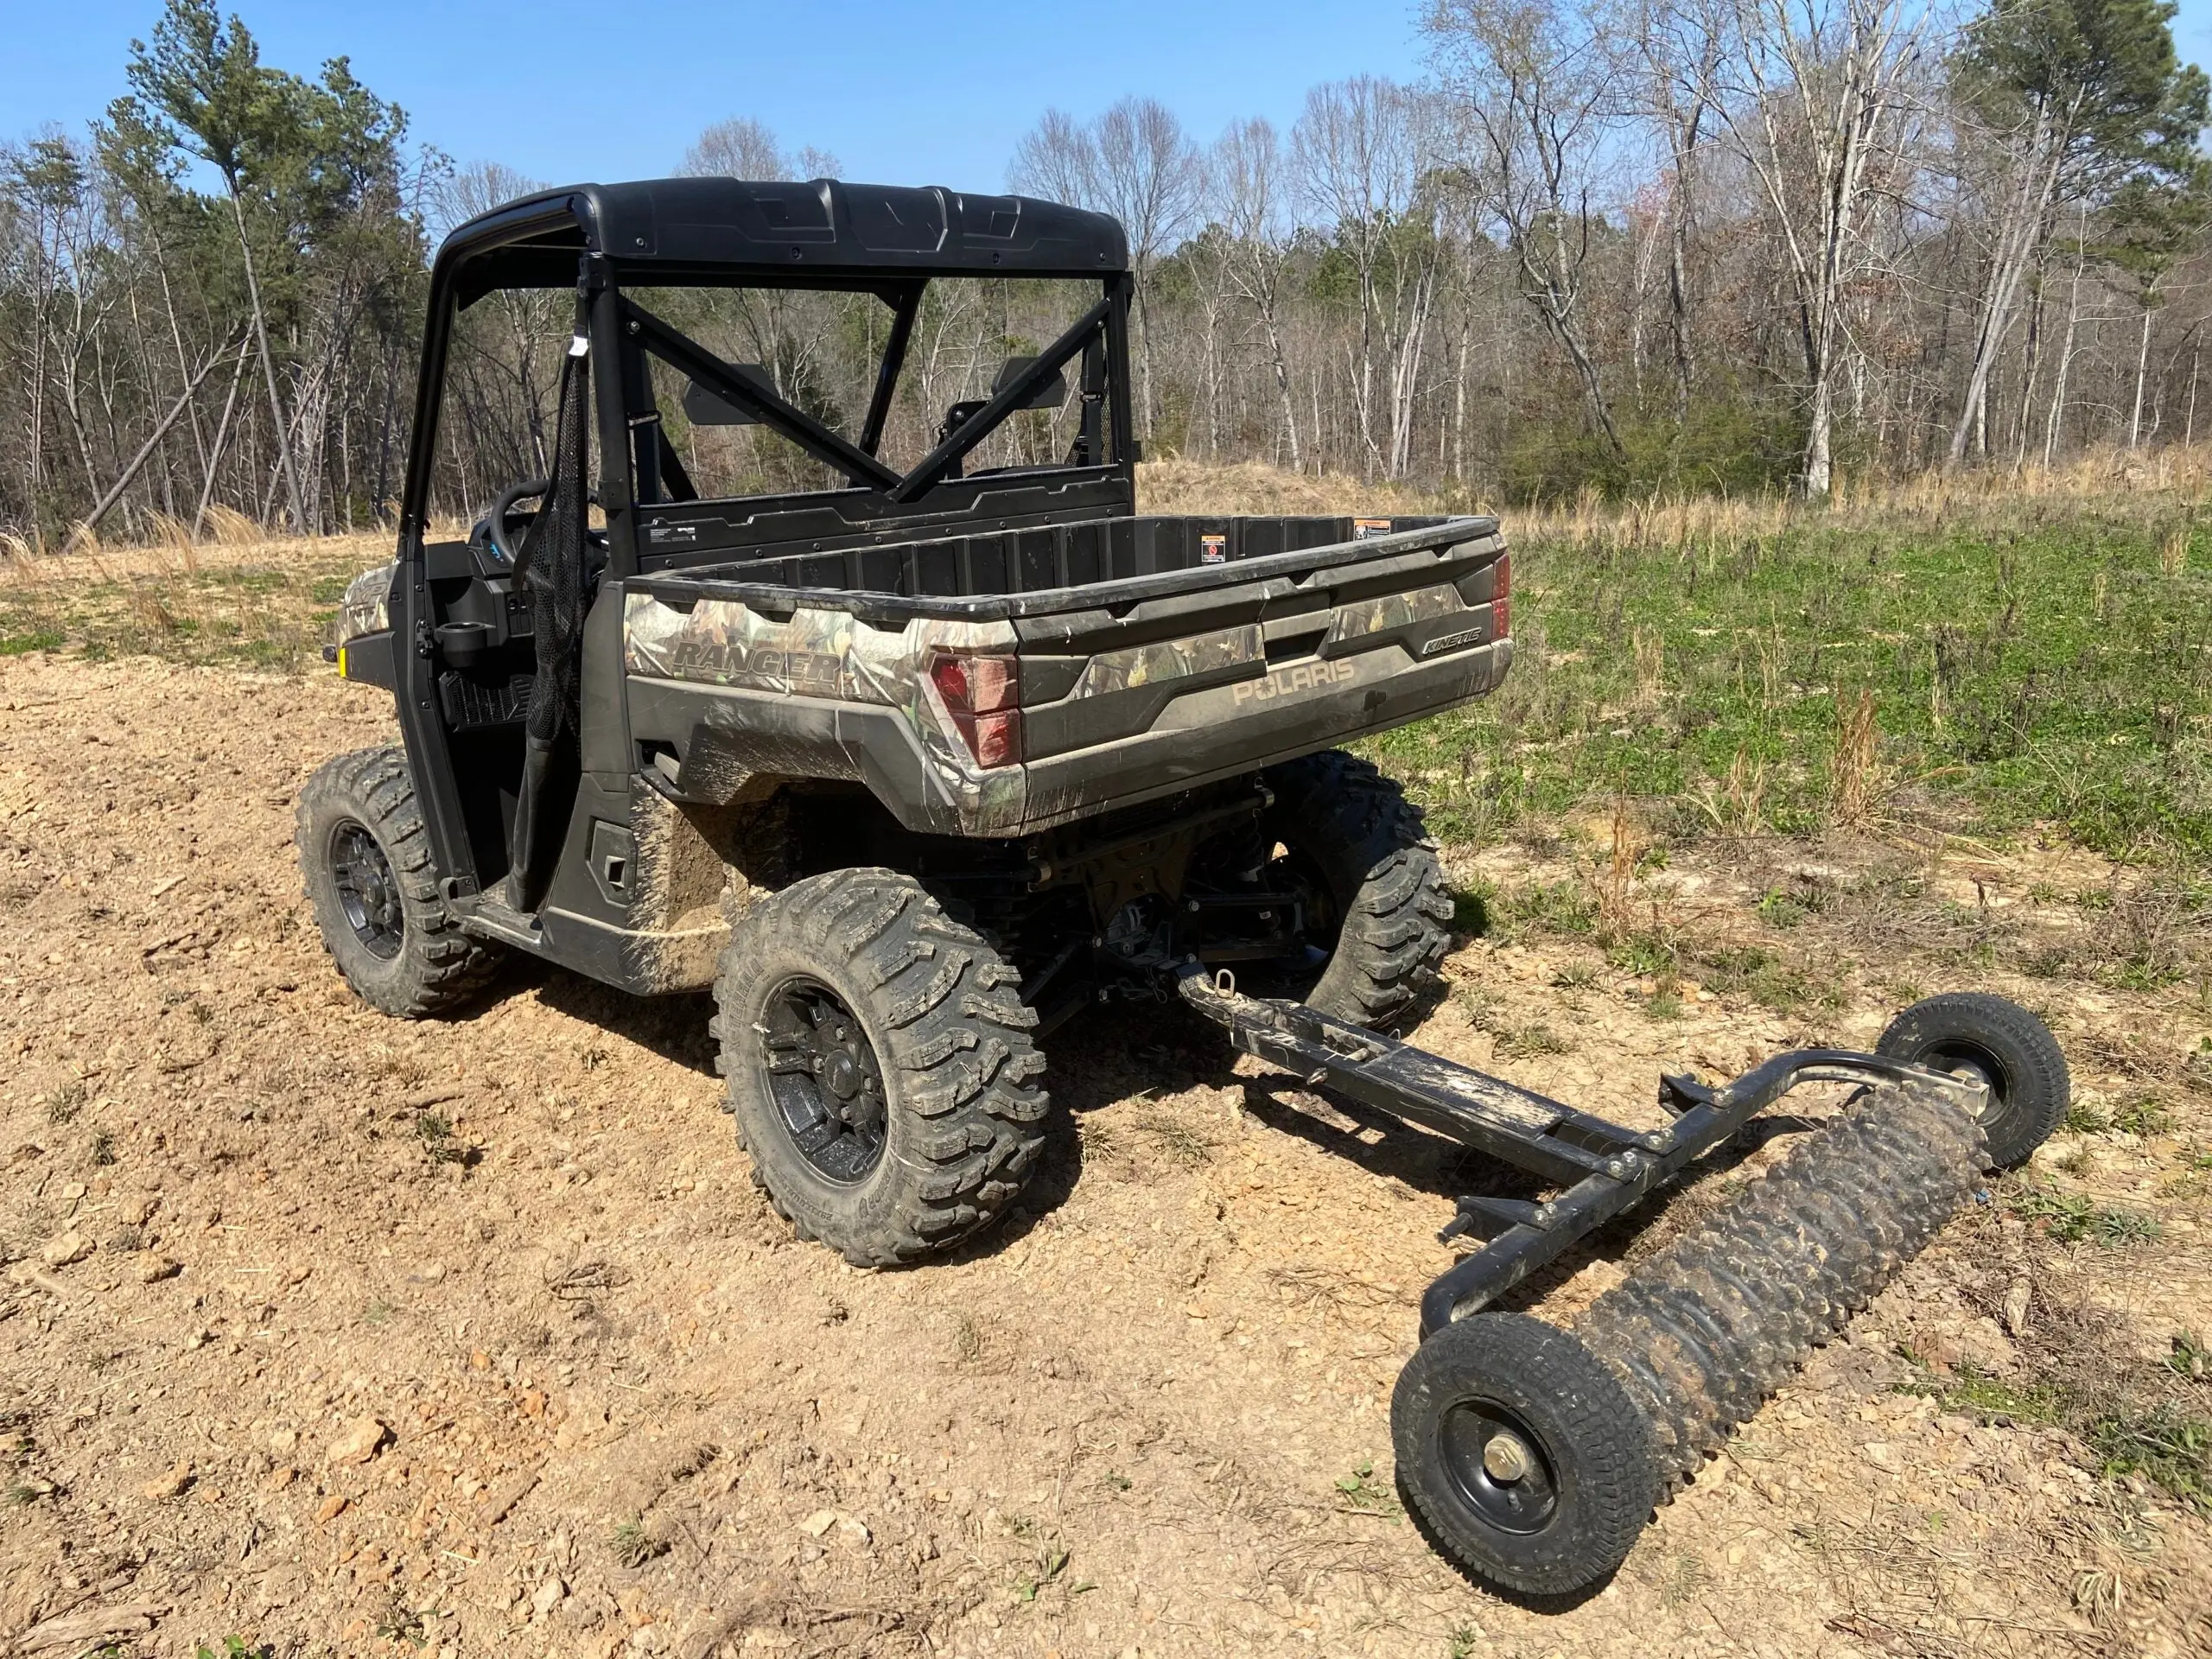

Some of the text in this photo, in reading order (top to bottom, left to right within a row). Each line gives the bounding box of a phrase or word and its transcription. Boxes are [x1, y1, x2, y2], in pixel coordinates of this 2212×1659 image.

[346, 581, 387, 608] XP
[673, 640, 842, 683] RANGER
[1422, 627, 1482, 654] KINETIC
[1231, 657, 1354, 706] POLARIS
[728, 957, 765, 1052] X-TERRAIN
